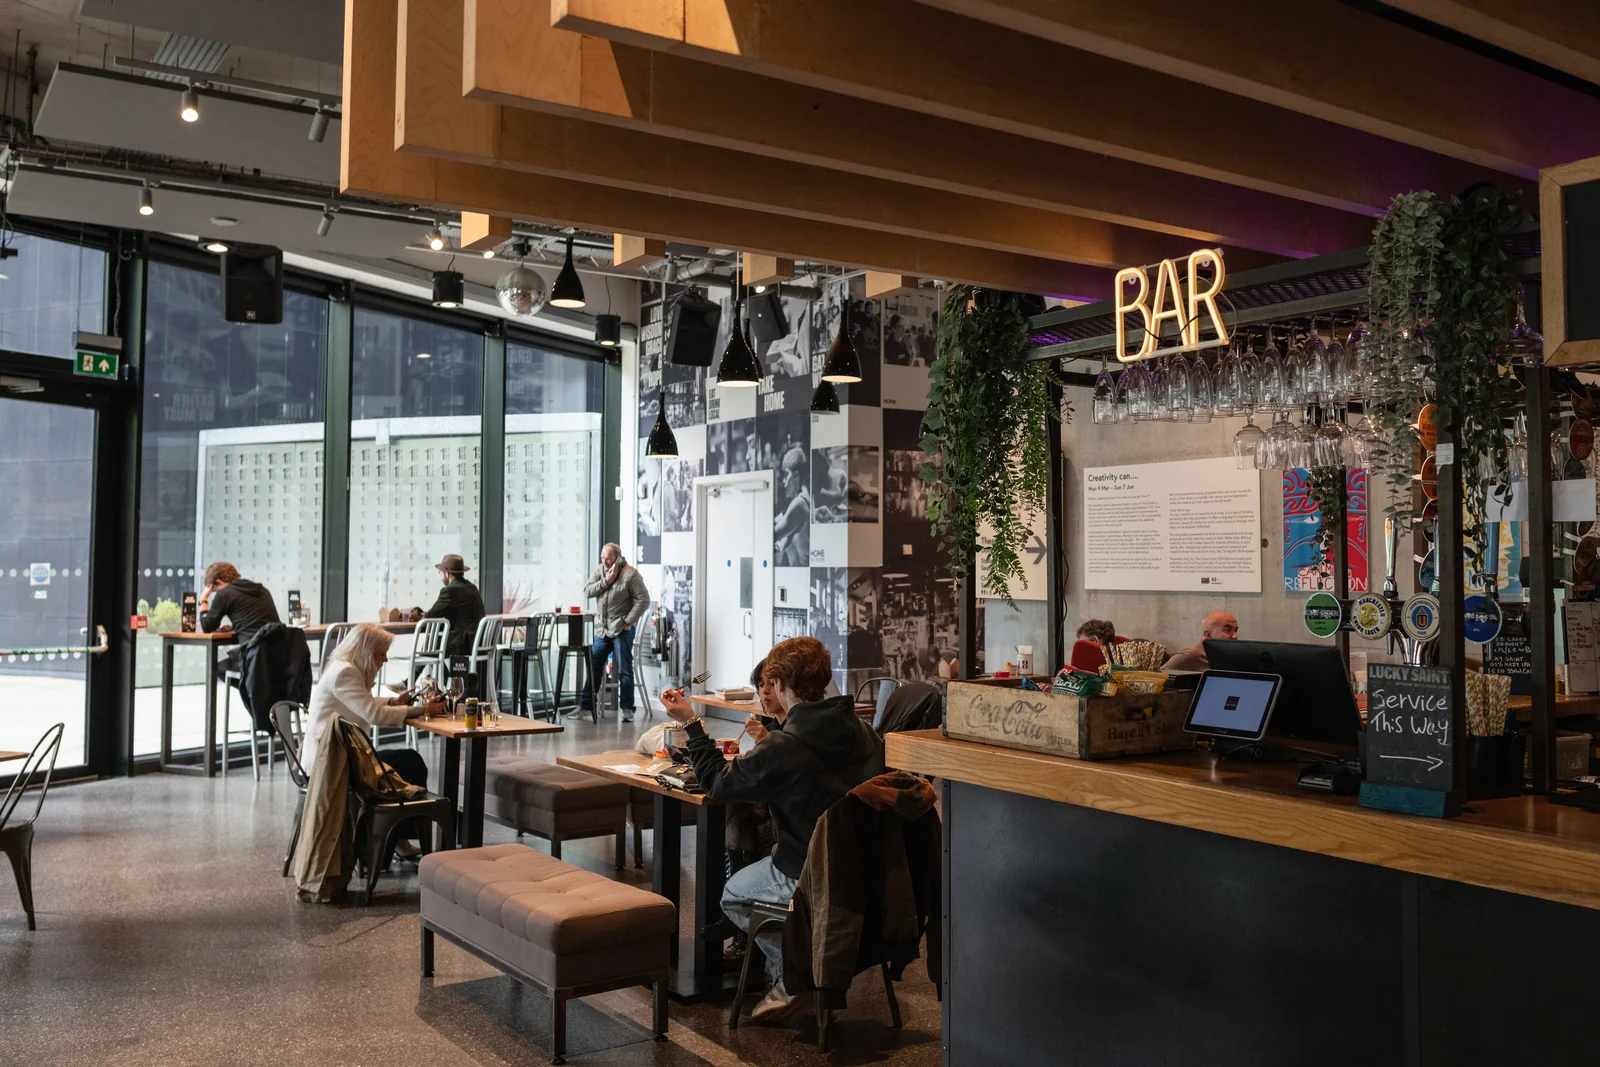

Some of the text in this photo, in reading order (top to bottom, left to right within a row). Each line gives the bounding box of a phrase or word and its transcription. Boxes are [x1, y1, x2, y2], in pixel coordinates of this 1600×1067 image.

[1114, 248, 1230, 363] BAR
[708, 388, 716, 399] EAT
[764, 390, 785, 412] HOME
[1088, 473, 1118, 482] Creativity
[810, 549, 825, 557] HOME
[1284, 576, 1369, 591] REFLECON
[1359, 597, 1386, 617] MANCHESTER
[1364, 626, 1380, 636] LAGER
[1368, 665, 1450, 684] LUCKY SAINT
[1372, 688, 1448, 712] Service
[1107, 727, 1136, 741] Have
[1370, 710, 1450, 746] This Way
